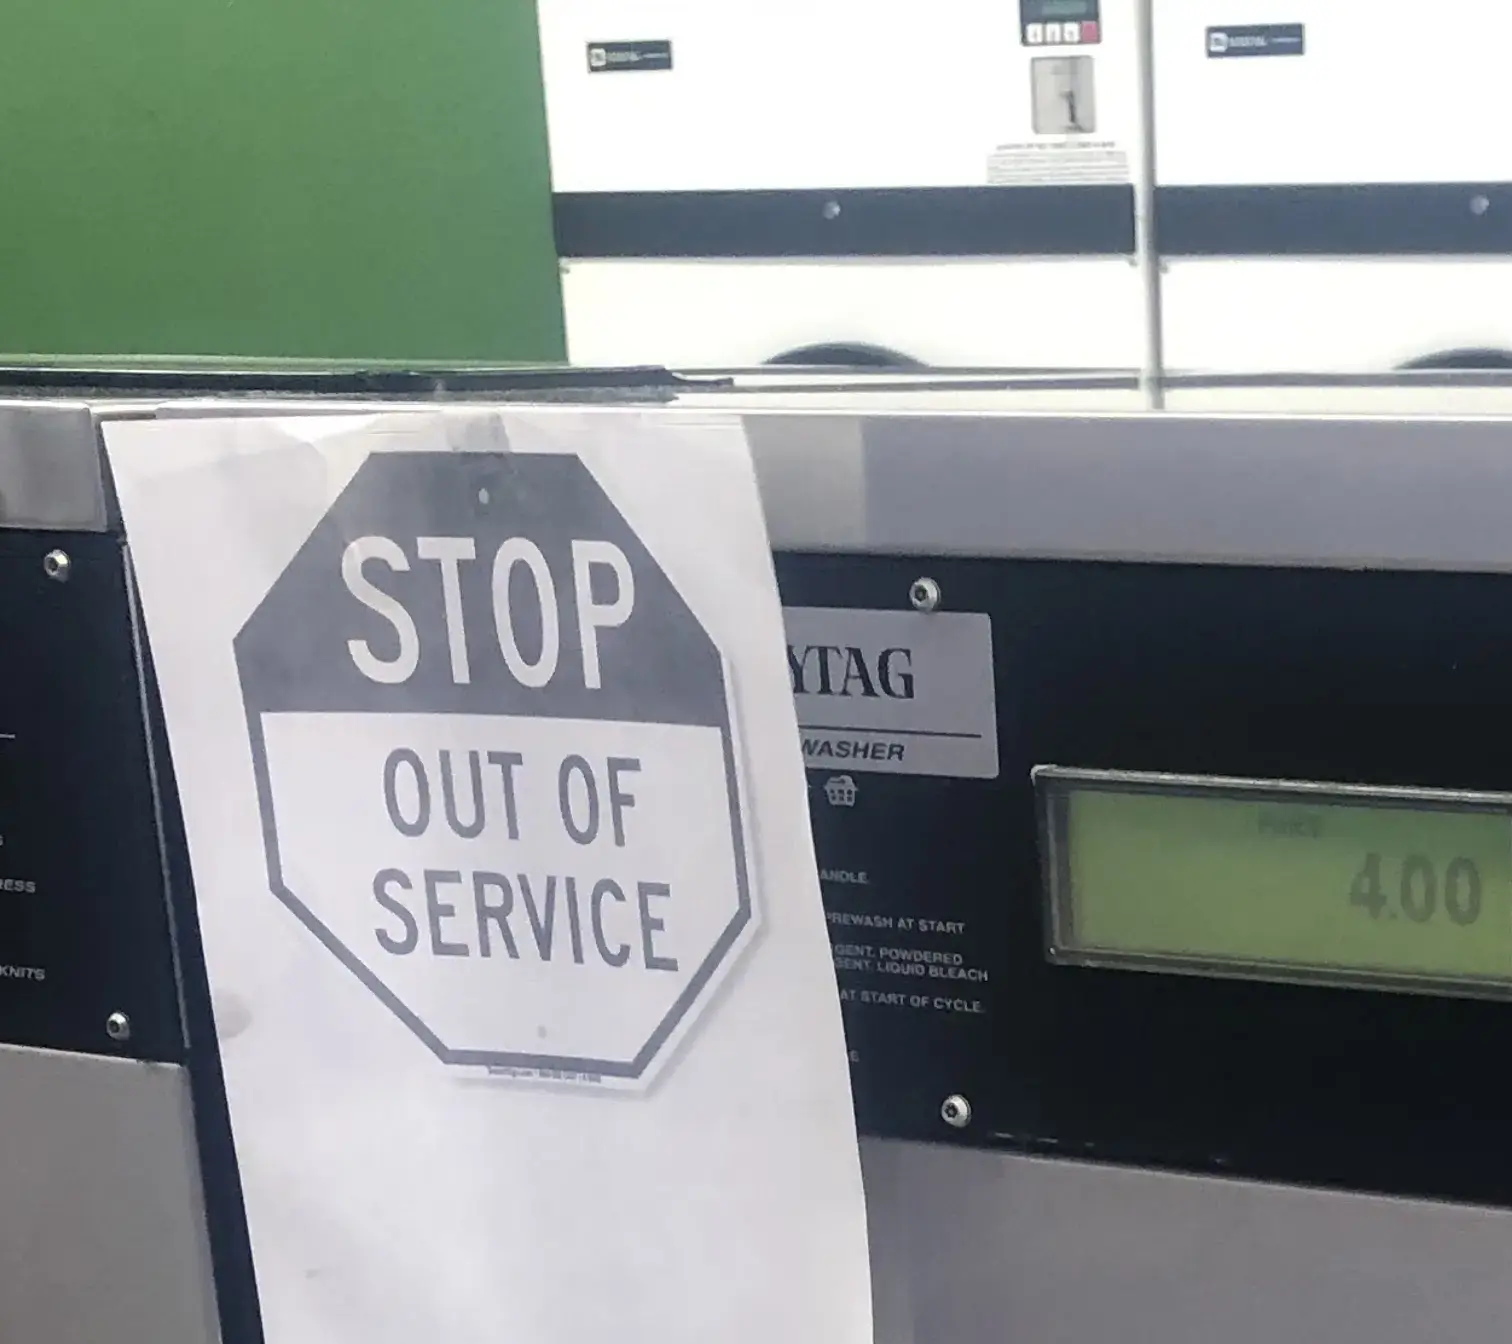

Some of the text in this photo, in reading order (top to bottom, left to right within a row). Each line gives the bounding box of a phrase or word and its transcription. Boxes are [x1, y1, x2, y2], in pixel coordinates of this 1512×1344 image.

[339, 534, 637, 691] STOP
[381, 747, 643, 848] OUT OF
[371, 868, 680, 972] SERVICE
[897, 917, 915, 931] AT
[918, 919, 967, 935] START
[879, 946, 963, 966] POWDERED
[876, 961, 926, 977] LIQUID
[928, 965, 990, 982] BLEACH
[860, 990, 907, 1006] START
[909, 994, 930, 1009] OF
